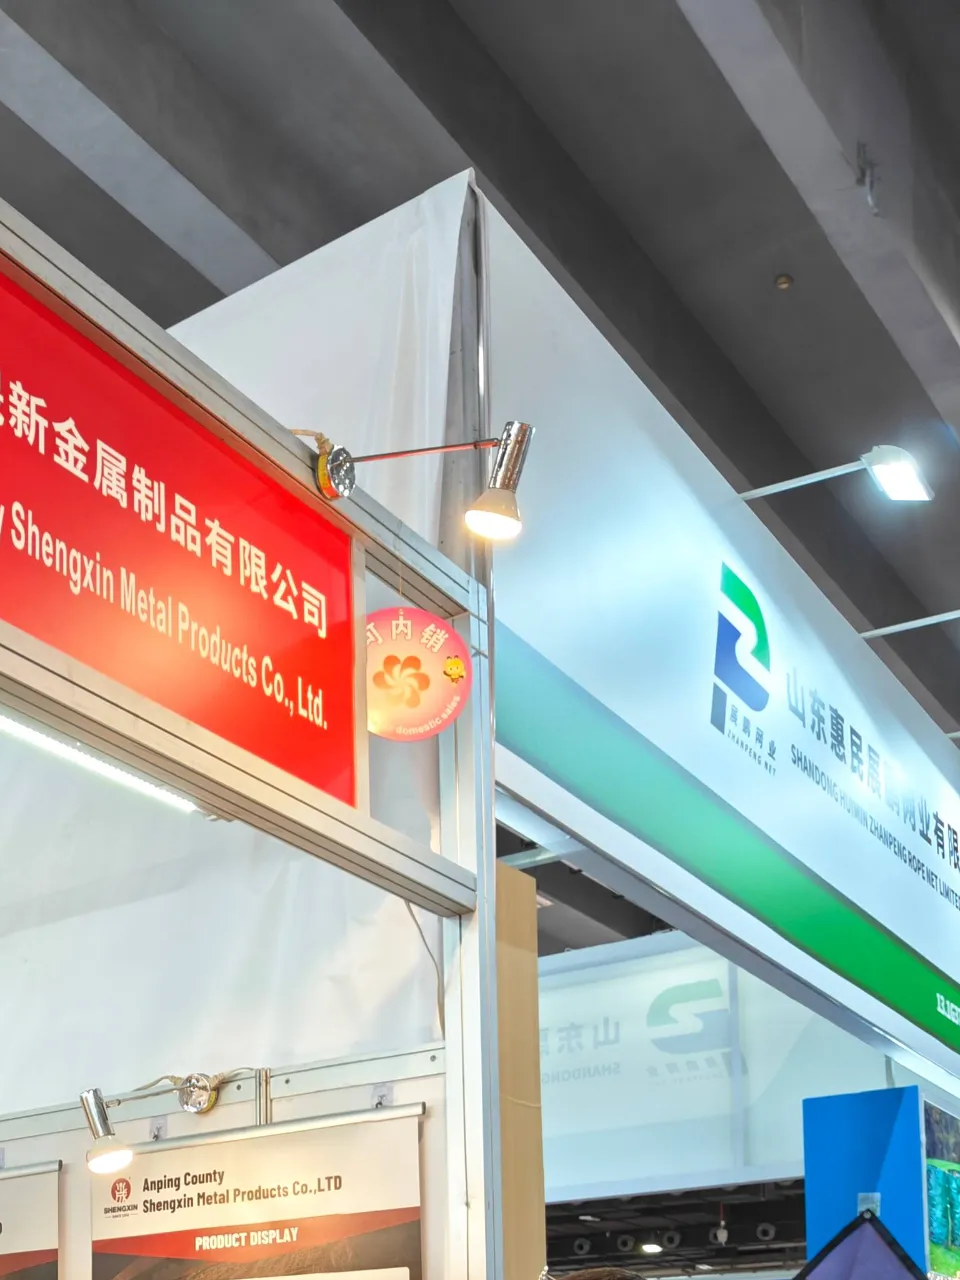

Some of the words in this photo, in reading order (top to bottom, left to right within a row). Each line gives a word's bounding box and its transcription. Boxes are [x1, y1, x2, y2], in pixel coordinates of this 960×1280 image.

[11, 501, 114, 604] Shengxin
[120, 566, 173, 636] Metal
[178, 603, 257, 688] Products
[395, 715, 442, 736] domestic
[440, 695, 461, 720] sales
[764, 761, 777, 776] NET
[791, 744, 838, 802] SHANDONG
[869, 815, 908, 865] ZHANPENG
[908, 850, 926, 881] ROPE
[926, 868, 938, 893] NET
[142, 1195, 193, 1213] Shengxin
[197, 1190, 229, 1206] Metal
[233, 1184, 289, 1203] Products
[292, 1175, 342, 1196] Co.,LTD
[143, 1175, 180, 1193] Anping
[184, 1169, 224, 1186] County
[103, 1204, 138, 1214] SHENGXIN
[195, 1233, 246, 1251] PRODUCT
[249, 1227, 298, 1246] DISPLAY
